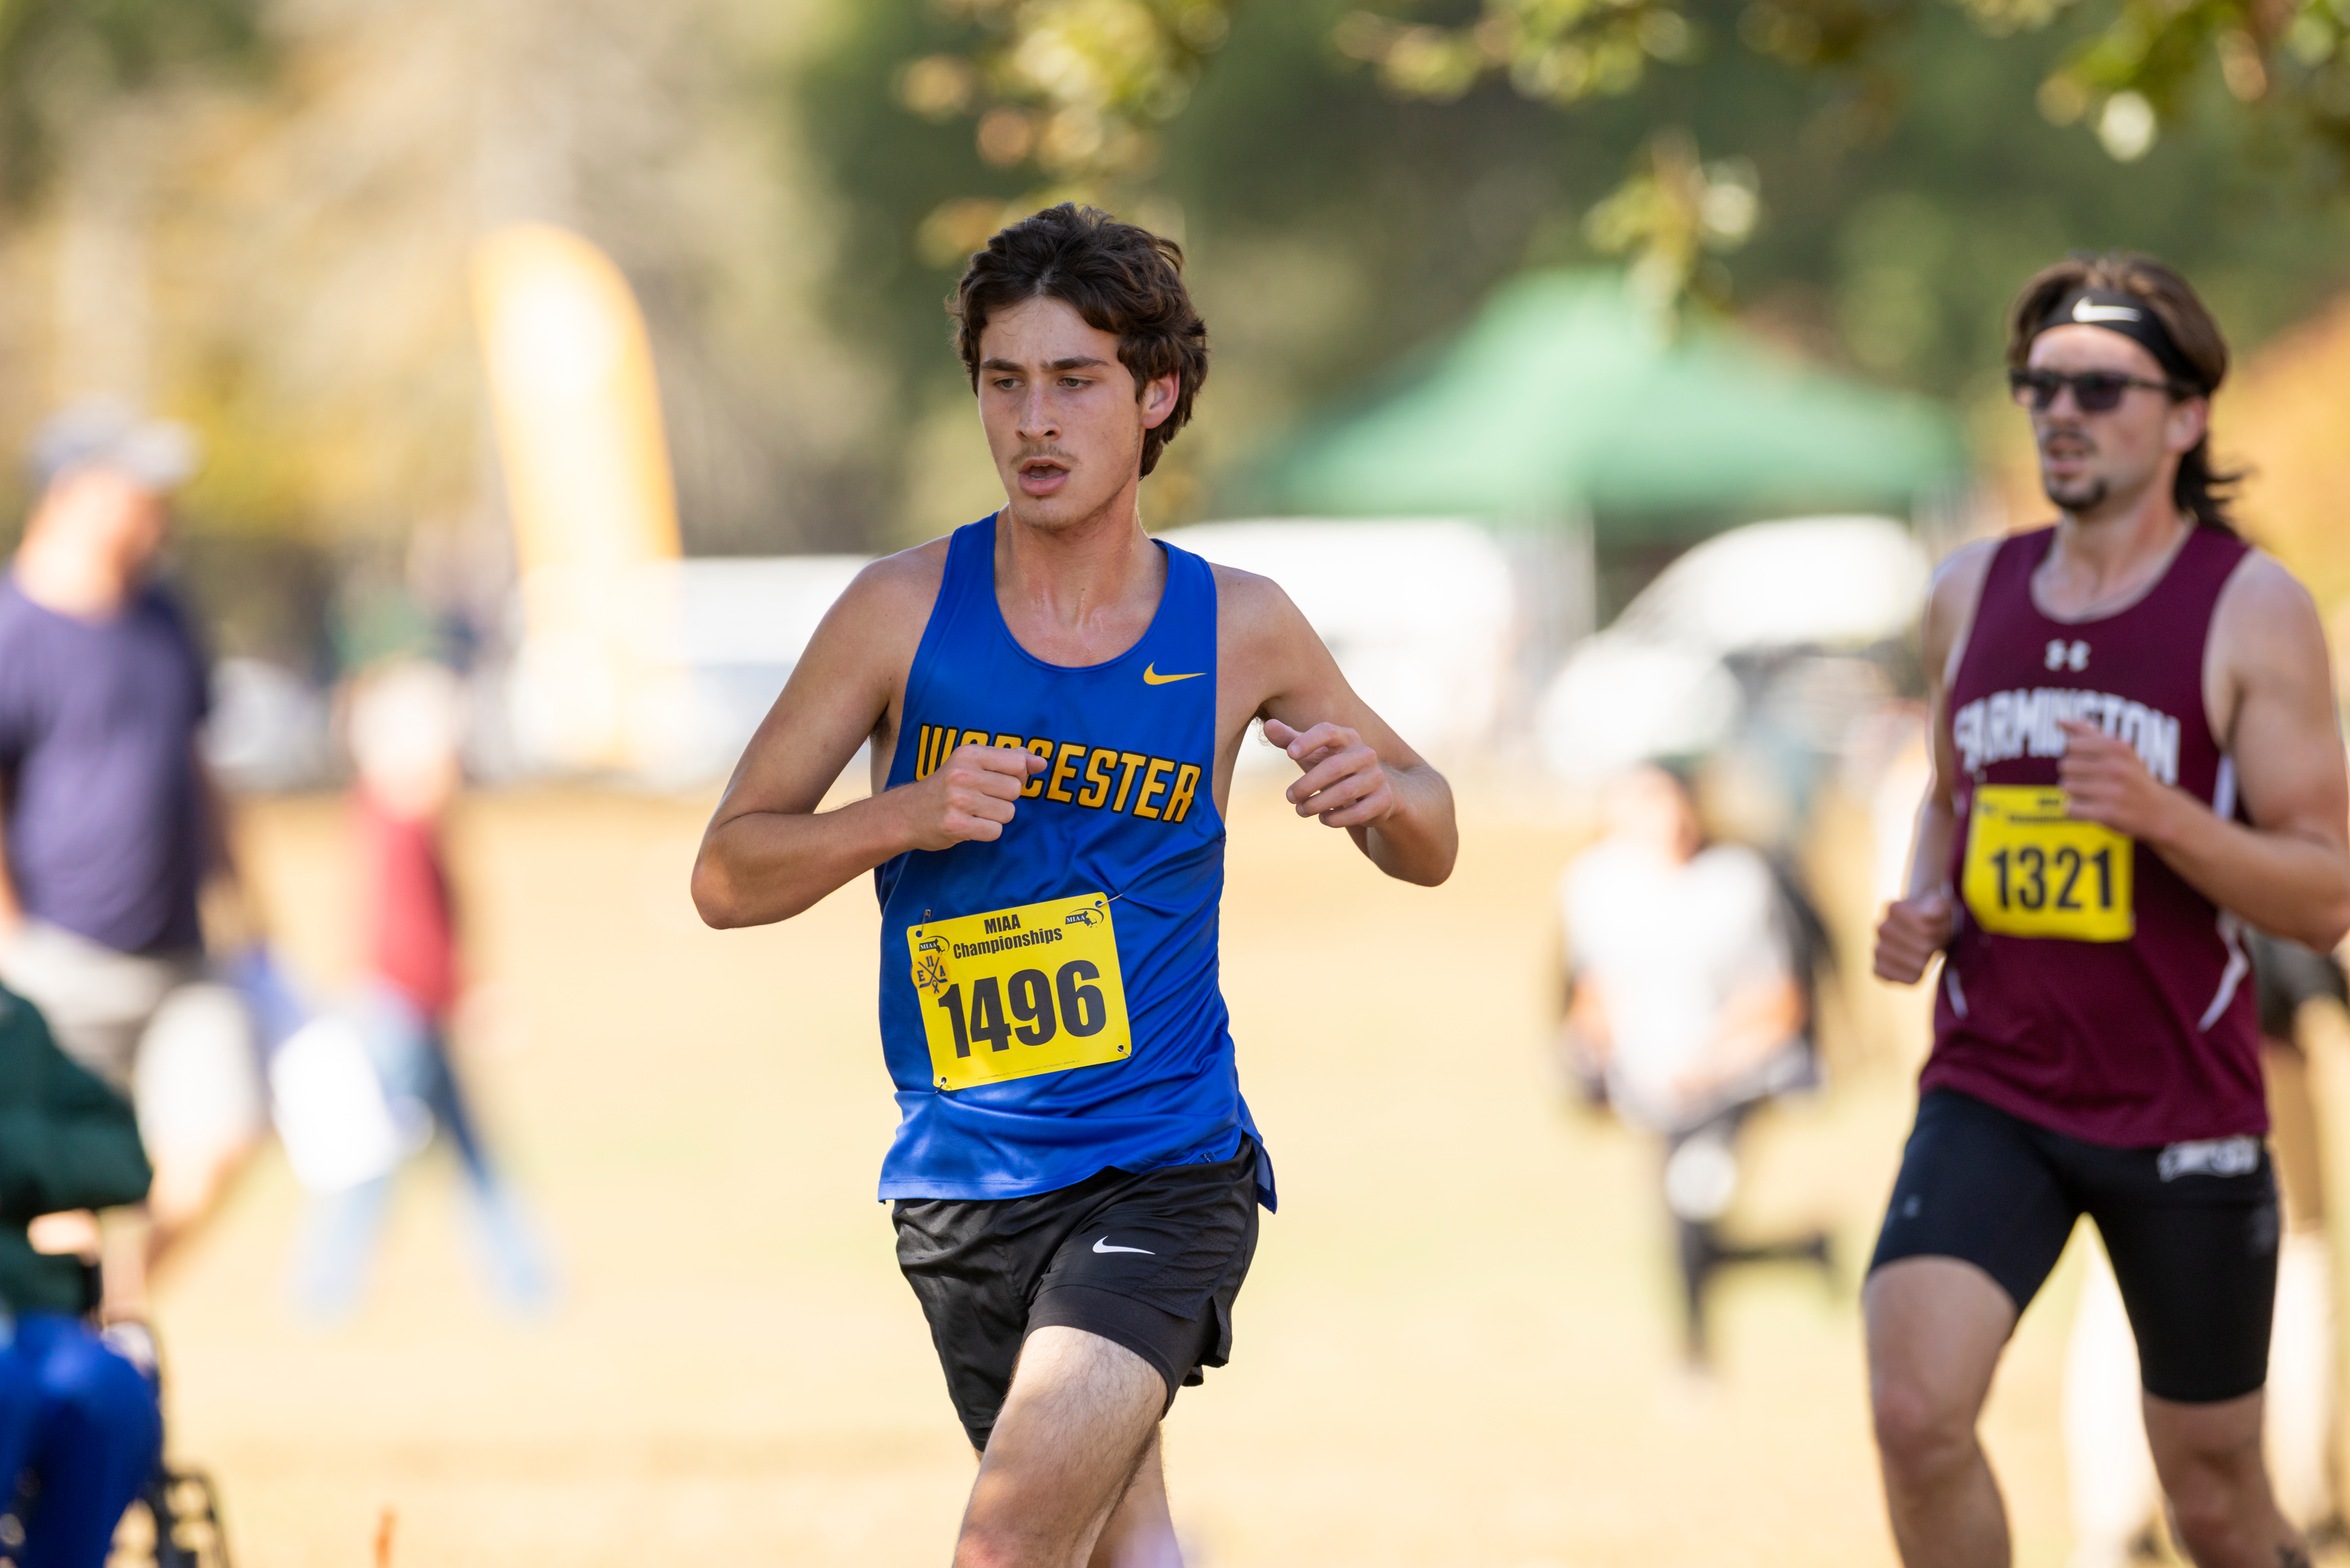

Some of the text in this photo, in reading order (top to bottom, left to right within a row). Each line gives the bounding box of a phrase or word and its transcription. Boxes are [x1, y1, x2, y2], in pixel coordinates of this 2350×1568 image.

[914, 723, 1202, 824] WCESTER
[1991, 845, 2114, 911] 1321
[954, 927, 1063, 959] Championships
[984, 914, 1021, 934] MIAA
[1066, 914, 1086, 924] MIAA
[938, 959, 1107, 1059] 1496
